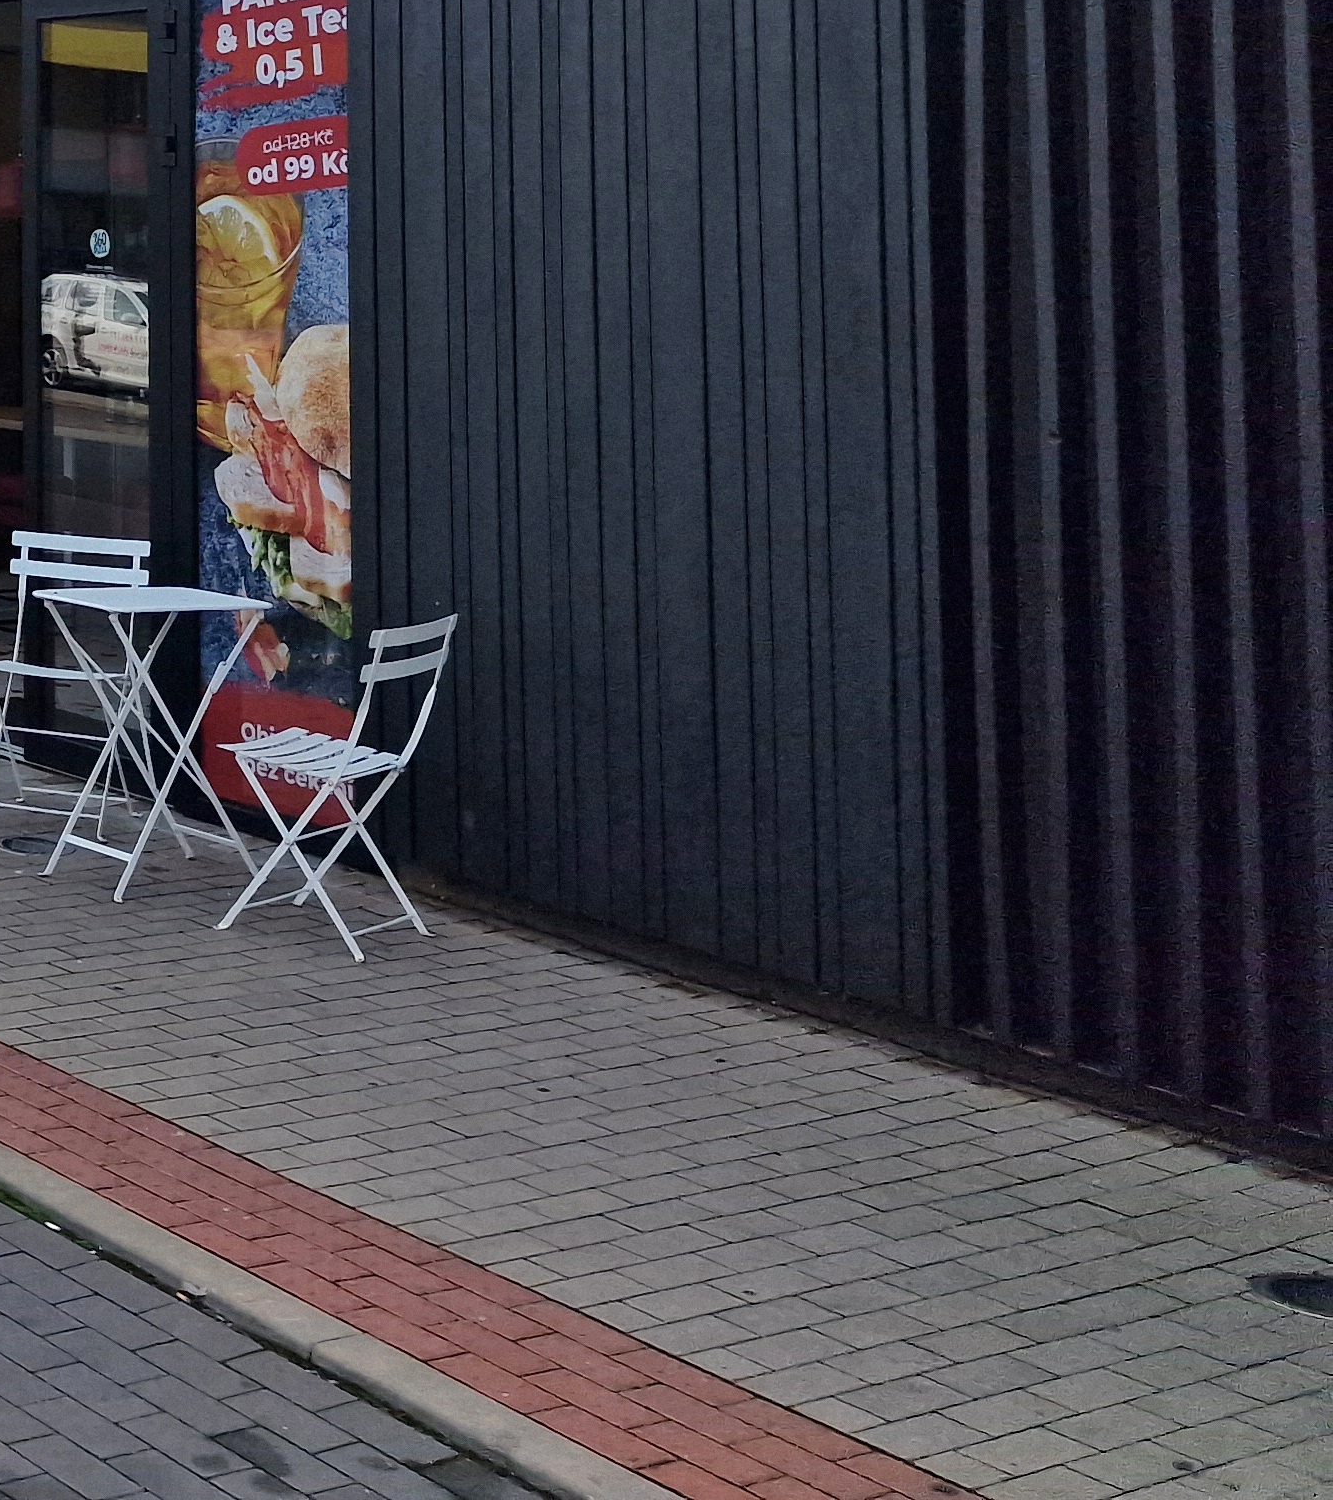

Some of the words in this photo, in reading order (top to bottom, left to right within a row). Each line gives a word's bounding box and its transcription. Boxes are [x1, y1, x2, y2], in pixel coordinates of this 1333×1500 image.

[216, 24, 238, 54] &
[247, 16, 293, 49] Ice
[256, 49, 304, 88] 0,5
[284, 131, 311, 150] 128
[247, 158, 277, 186] od
[283, 154, 315, 180] 99
